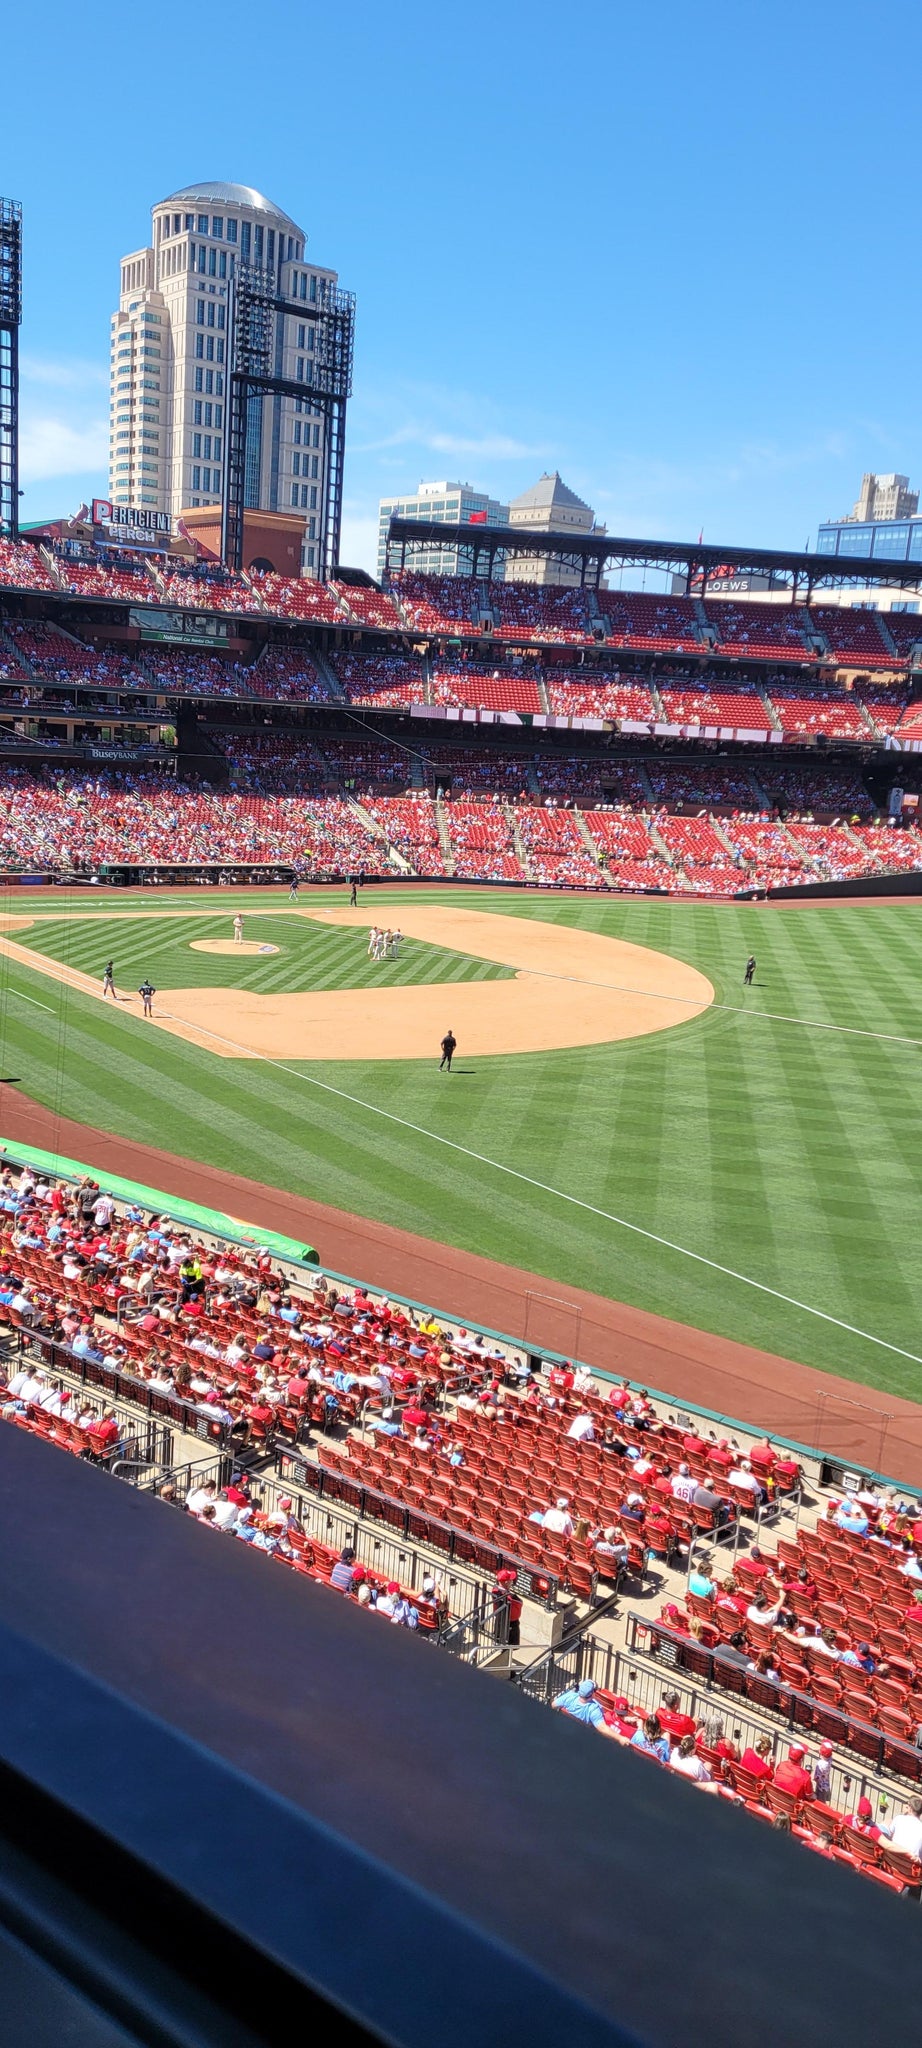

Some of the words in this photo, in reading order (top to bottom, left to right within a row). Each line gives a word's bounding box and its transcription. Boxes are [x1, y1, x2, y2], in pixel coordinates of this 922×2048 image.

[93, 500, 172, 531] PERFICIENT
[109, 526, 155, 542] PERCH
[706, 581, 748, 591] LOEWS
[676, 1487, 689, 1499] 46
